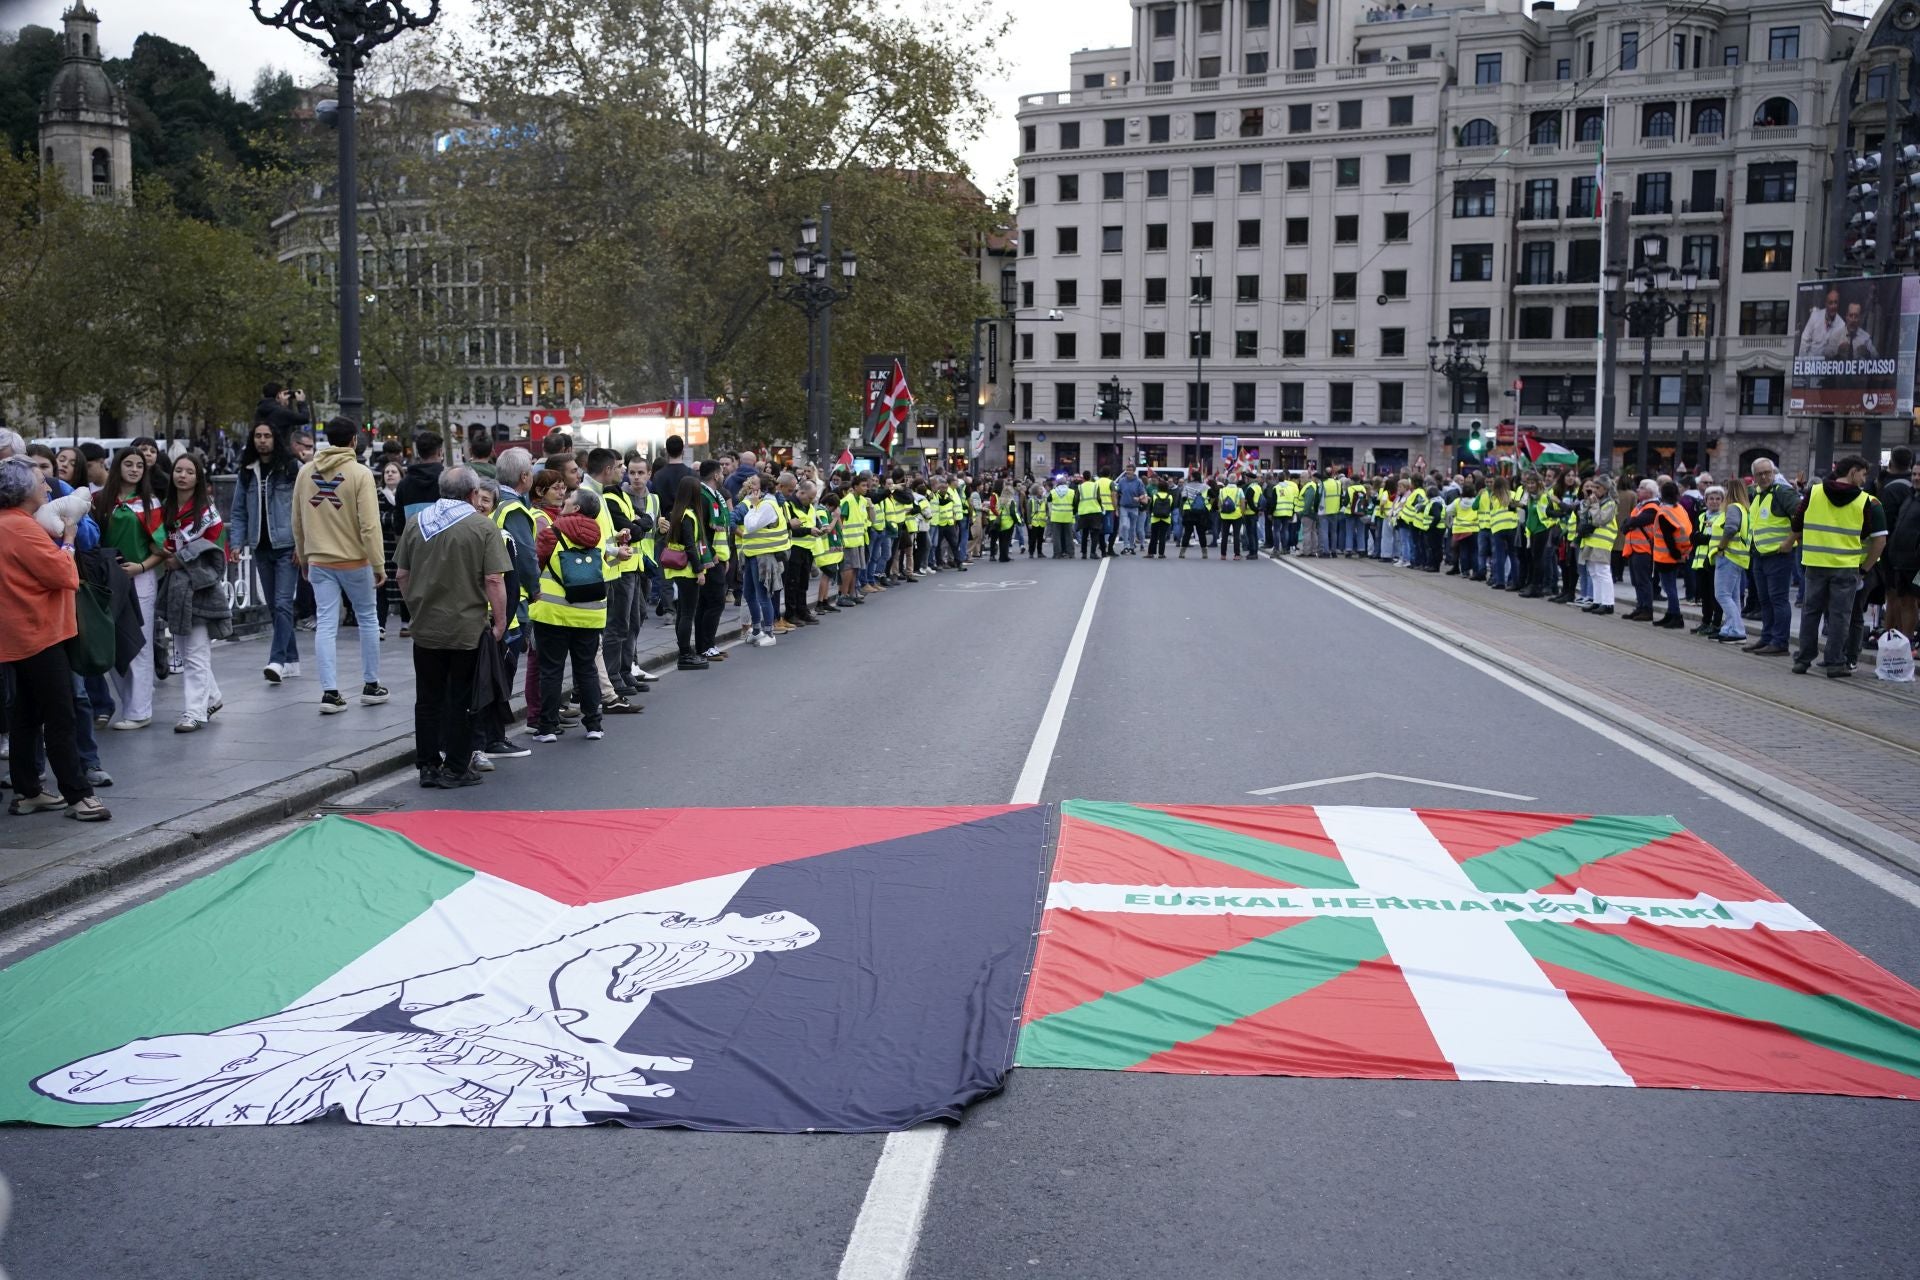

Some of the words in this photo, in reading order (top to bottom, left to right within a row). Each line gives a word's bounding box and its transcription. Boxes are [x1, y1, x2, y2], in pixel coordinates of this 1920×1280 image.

[1793, 360, 1804, 375] EL
[1804, 360, 1844, 375] BARBERO
[1845, 360, 1857, 375] DE
[1858, 359, 1895, 375] PICASSO
[1264, 429, 1278, 437] NYX
[1281, 429, 1301, 438] HOTEL
[1124, 892, 1304, 909] EUSKAL
[1311, 896, 1524, 913] HERRIAK
